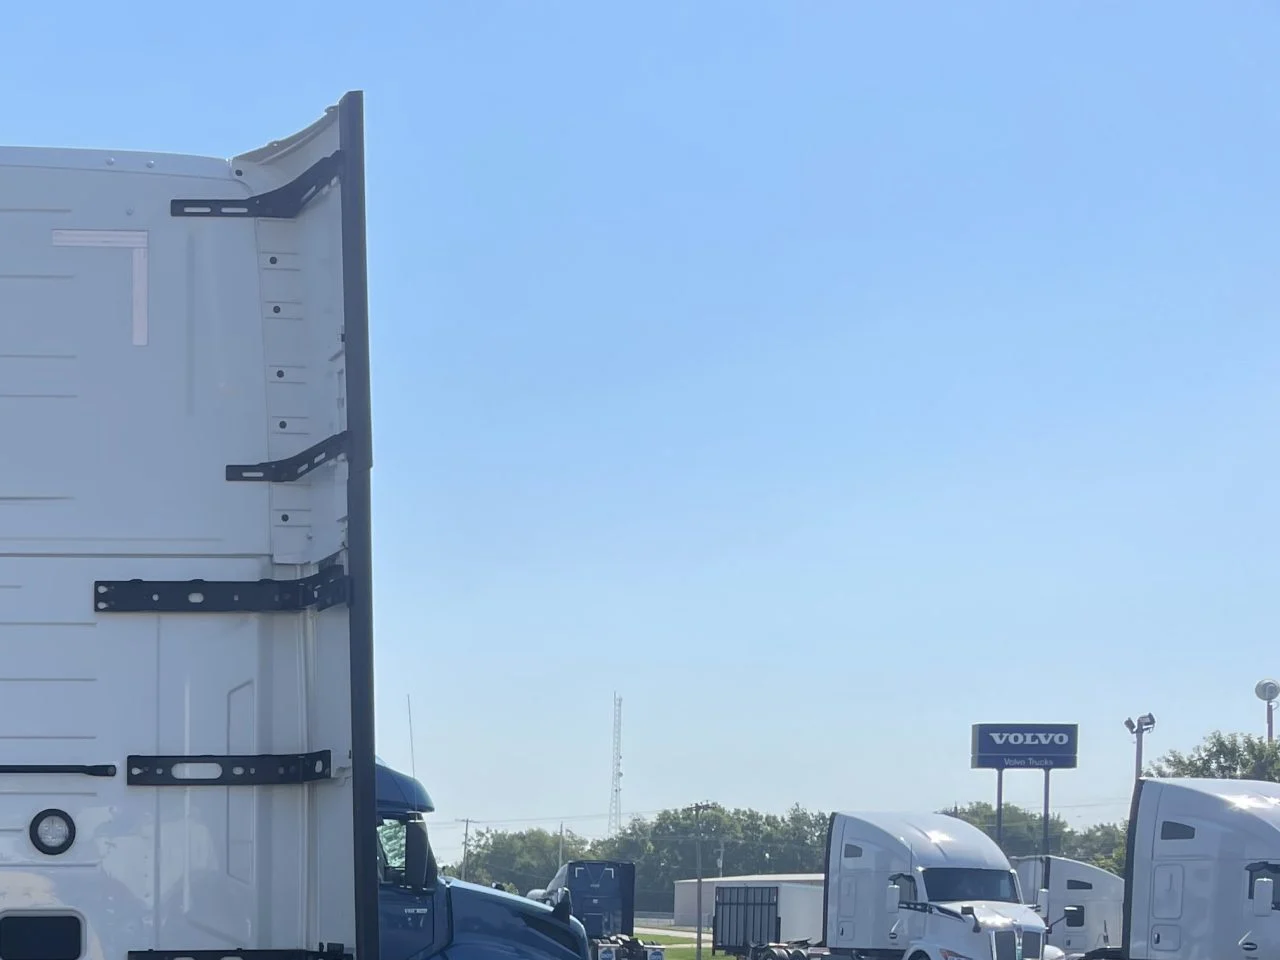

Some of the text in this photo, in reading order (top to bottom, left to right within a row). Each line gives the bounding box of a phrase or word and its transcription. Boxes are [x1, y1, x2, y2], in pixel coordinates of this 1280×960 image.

[989, 733, 1069, 745] VOLVO
[1004, 758, 1053, 766] Volvo Trucks
